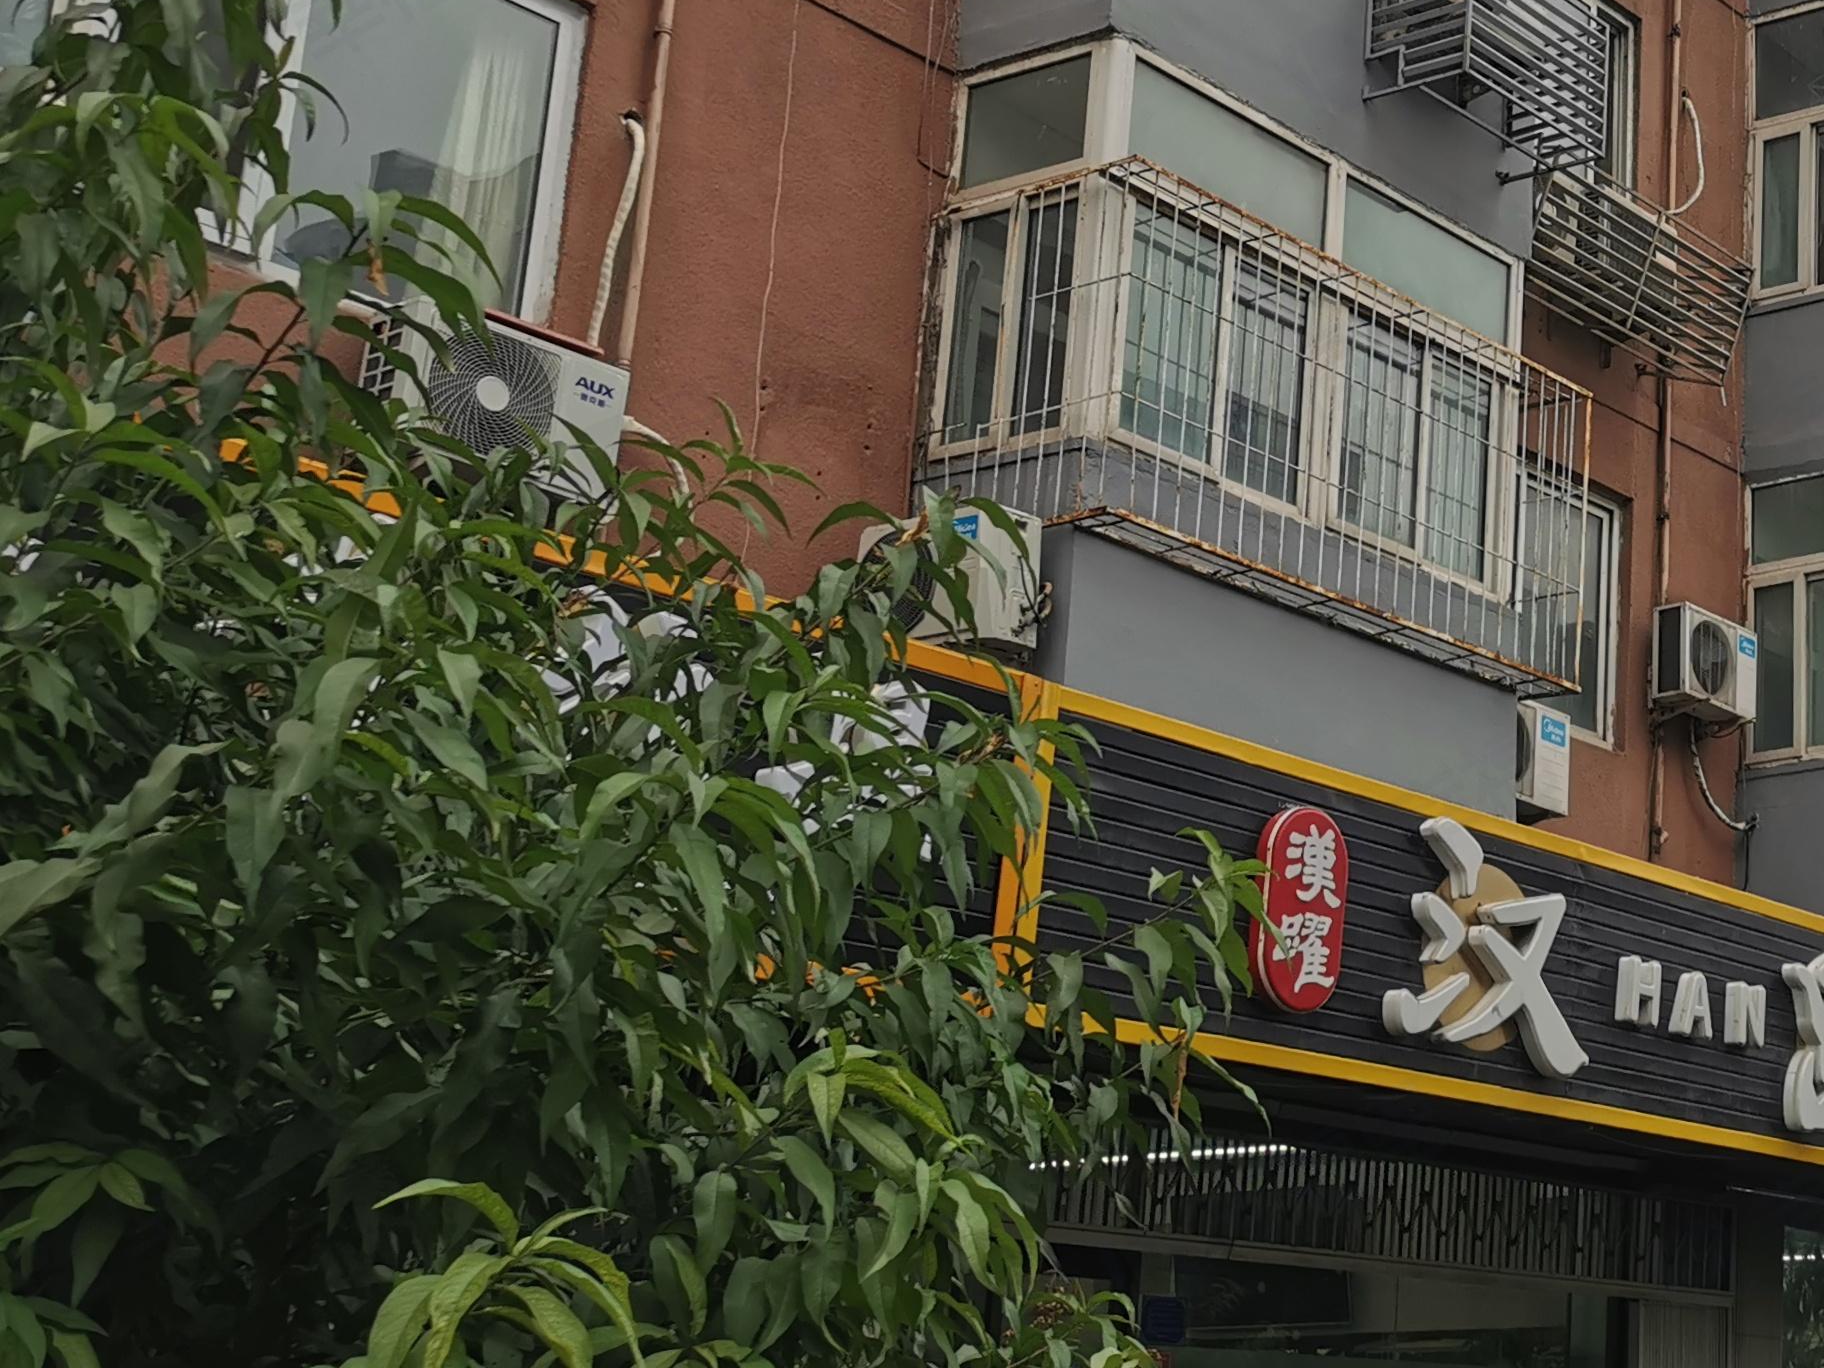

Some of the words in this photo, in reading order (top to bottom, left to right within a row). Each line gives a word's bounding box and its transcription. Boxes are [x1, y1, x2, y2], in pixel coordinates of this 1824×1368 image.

[575, 376, 615, 399] AUX
[1382, 815, 1590, 1079] 汉
[1614, 954, 1767, 1048] HAN
